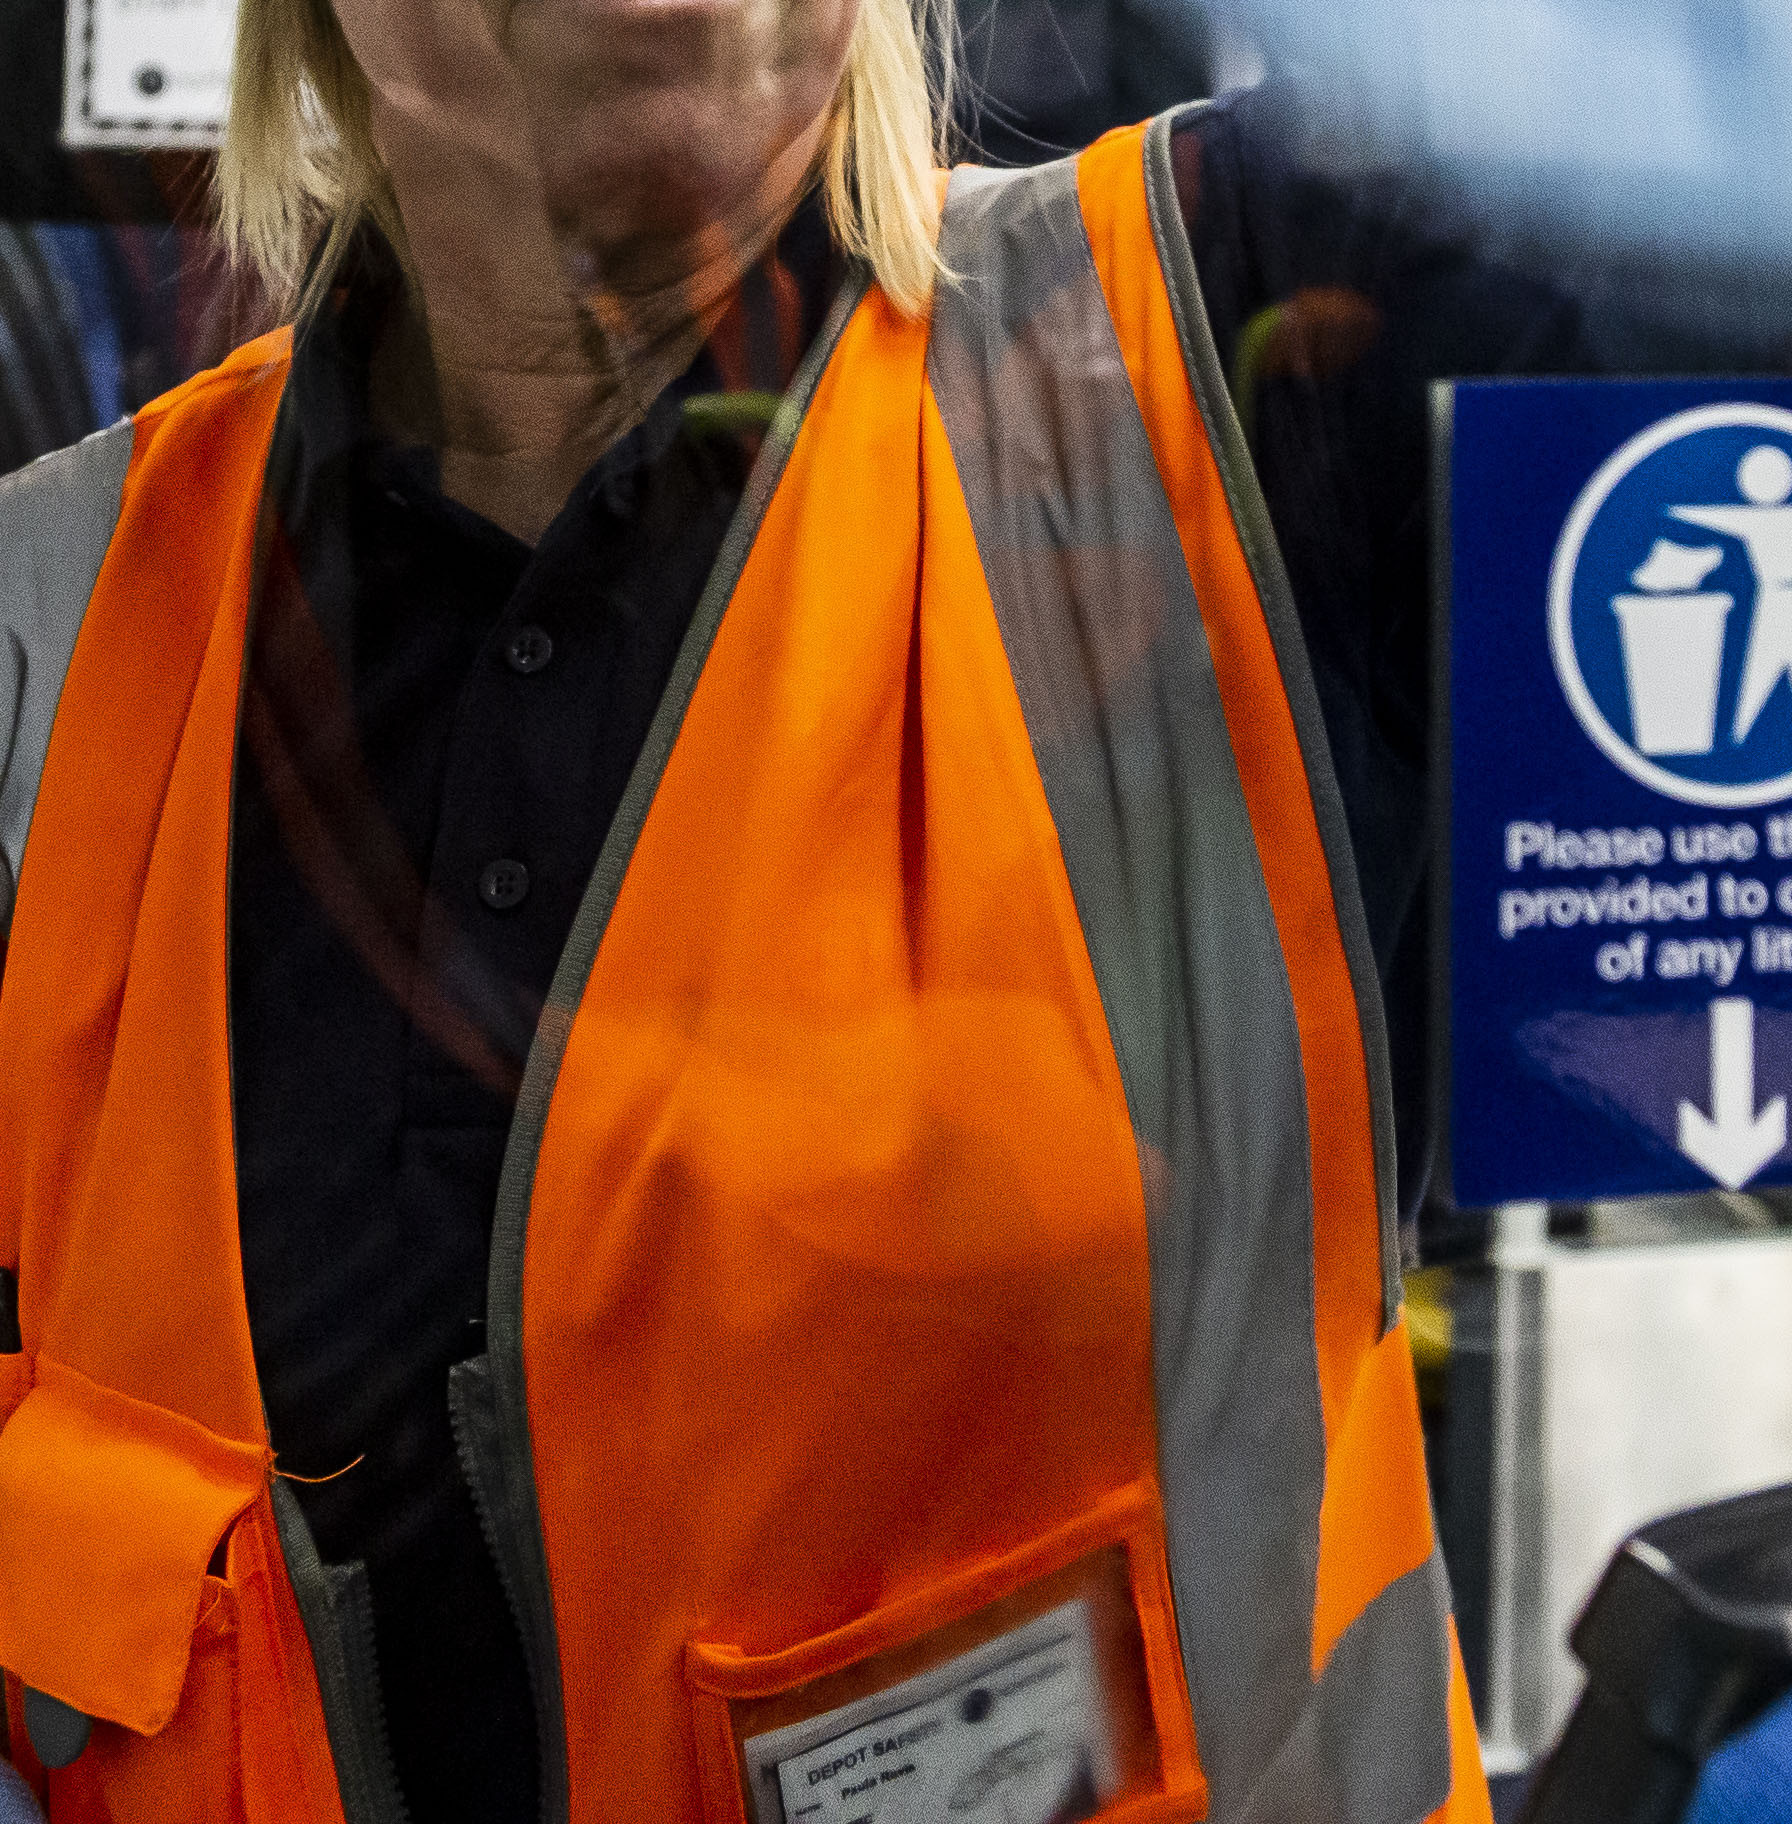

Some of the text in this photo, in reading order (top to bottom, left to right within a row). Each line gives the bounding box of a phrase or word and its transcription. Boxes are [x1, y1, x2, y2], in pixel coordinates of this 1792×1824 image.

[1505, 820, 1666, 871] Please
[1671, 822, 1758, 863] use
[1499, 872, 1708, 939] provided
[1717, 873, 1768, 918] to
[1596, 931, 1648, 982] of
[1655, 938, 1744, 987] any
[808, 1747, 867, 1785] DEPOT
